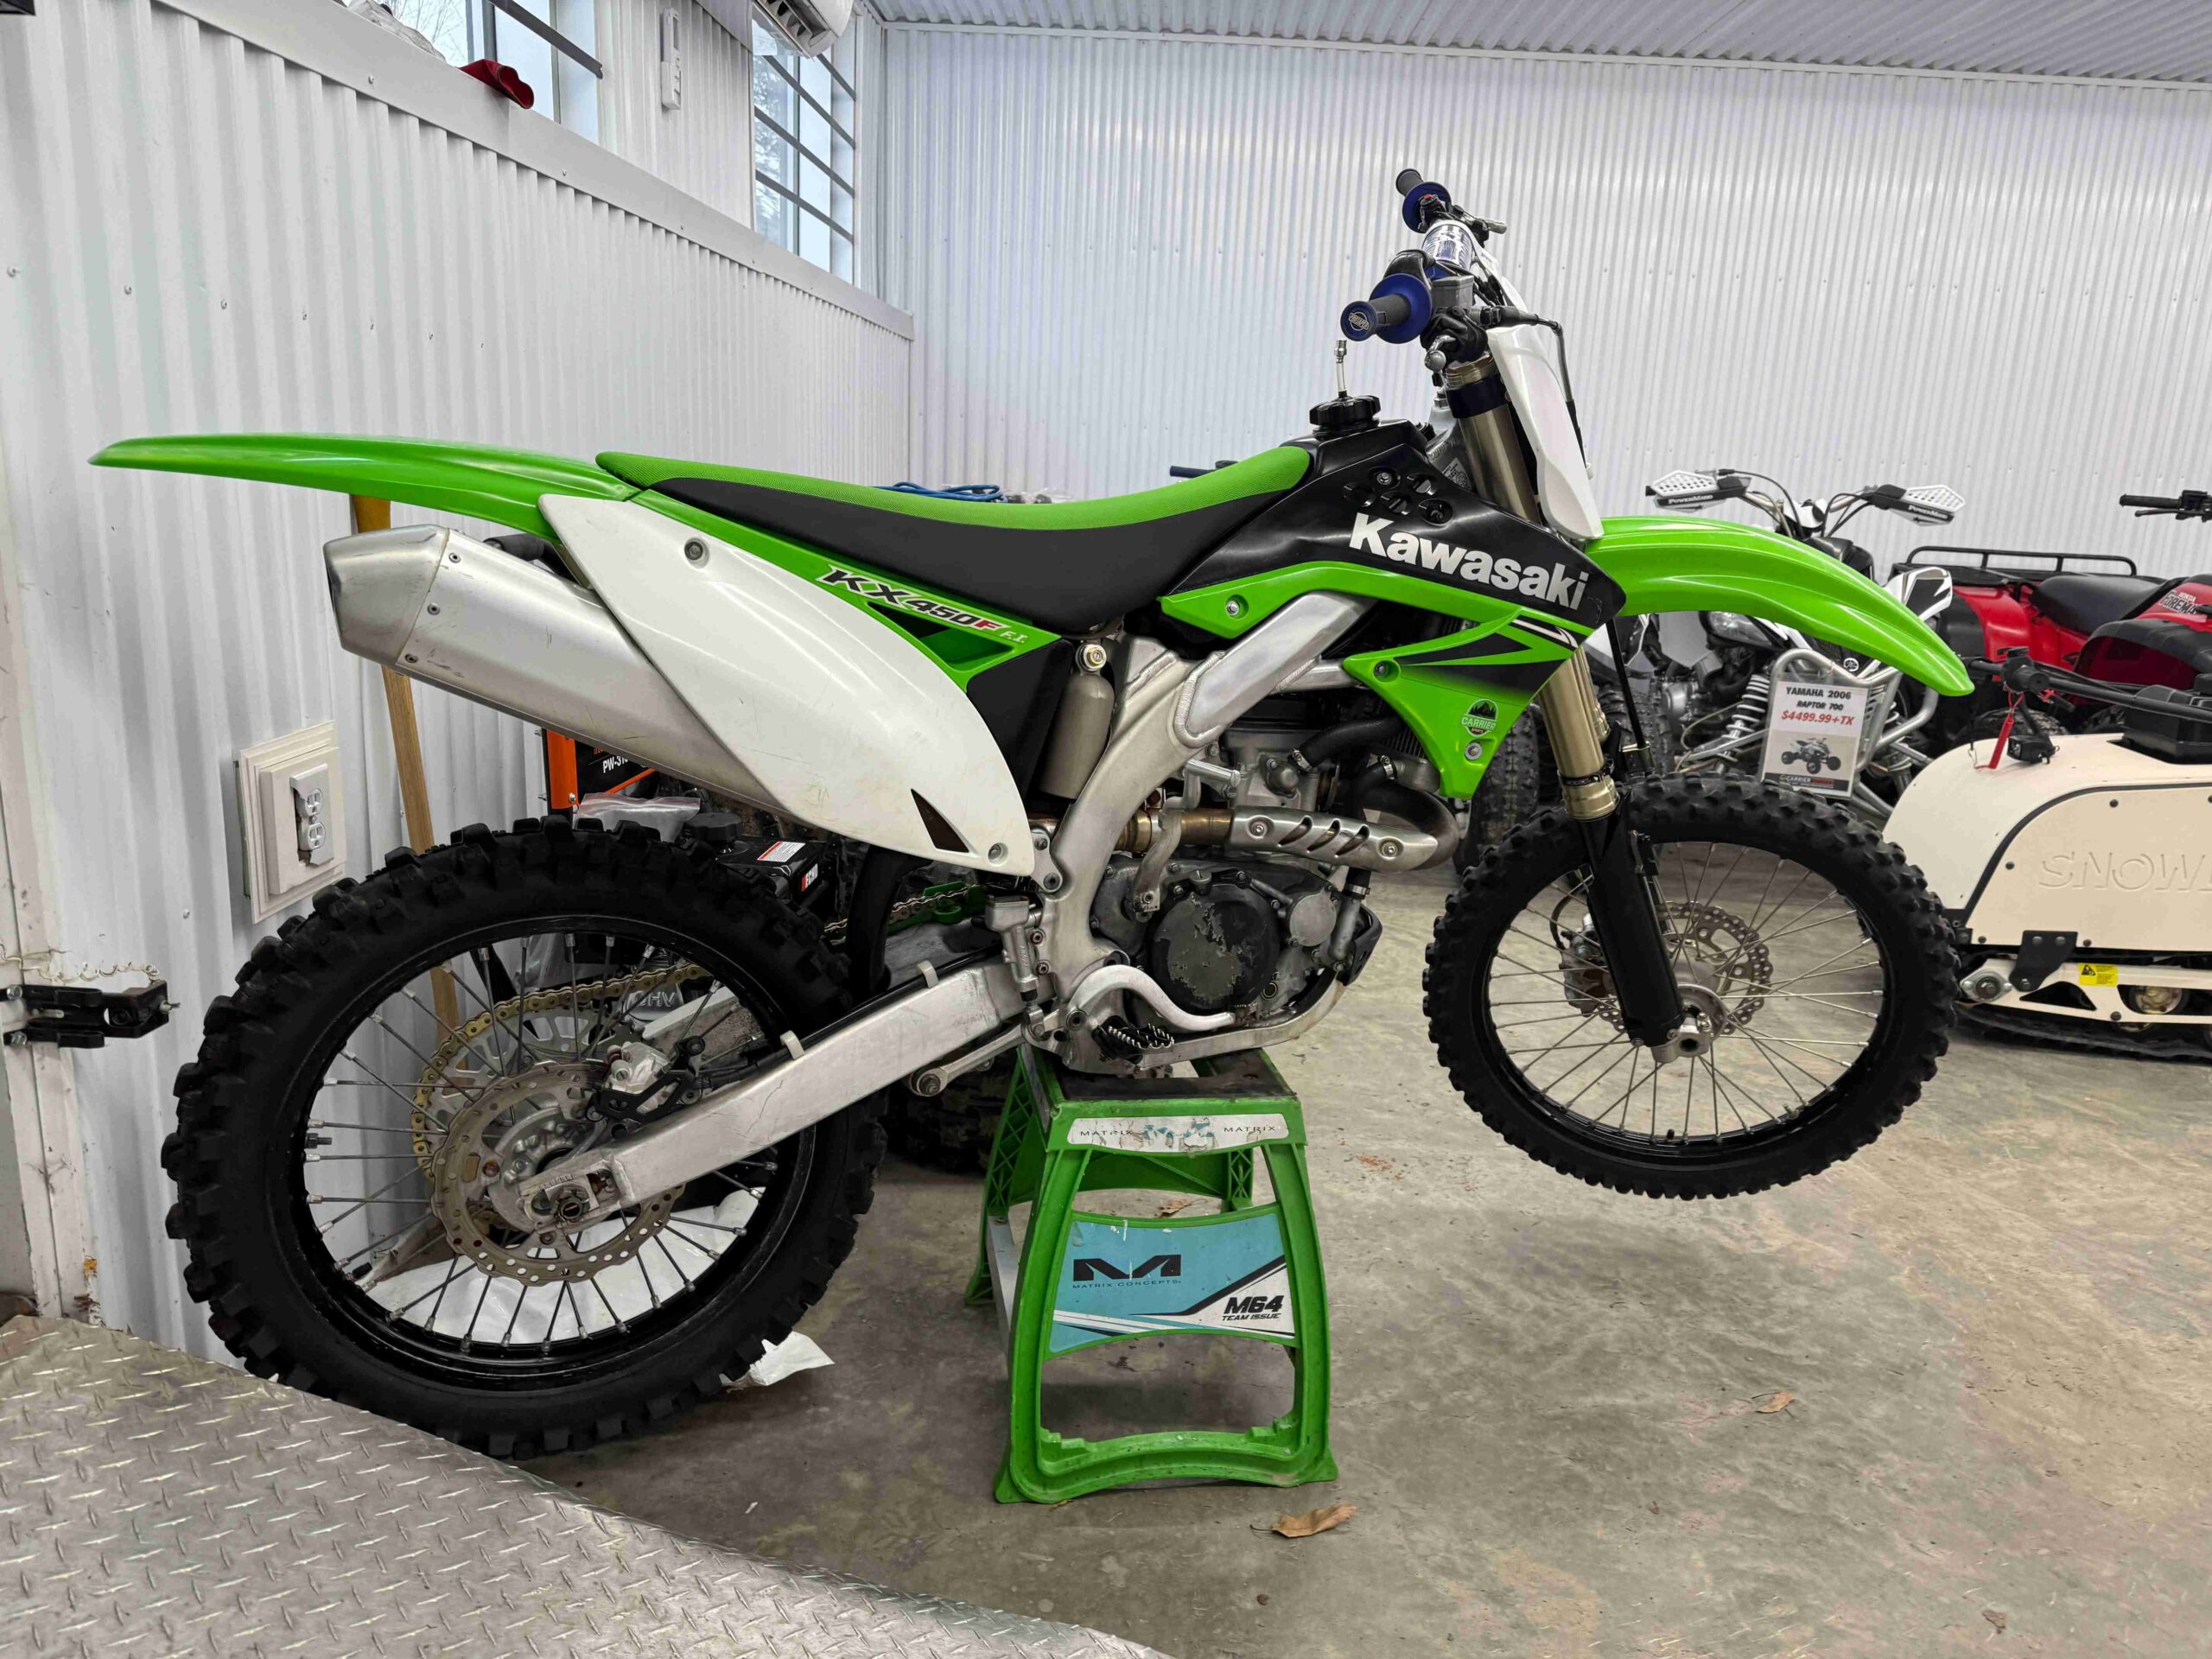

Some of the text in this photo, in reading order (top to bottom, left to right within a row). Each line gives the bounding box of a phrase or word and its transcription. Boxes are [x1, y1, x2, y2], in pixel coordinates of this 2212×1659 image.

[1349, 512, 1590, 610] Kawasaki
[817, 563, 1012, 632] KX450F
[1786, 686, 1852, 700] YAMAHA 2006
[1796, 700, 1844, 711] RAPTOR 700
[1461, 716, 1497, 731] CARRIER
[1782, 710, 1854, 726] $4499.99+TX
[2037, 850, 2212, 893] SNOW
[1224, 1295, 1285, 1314] M64
